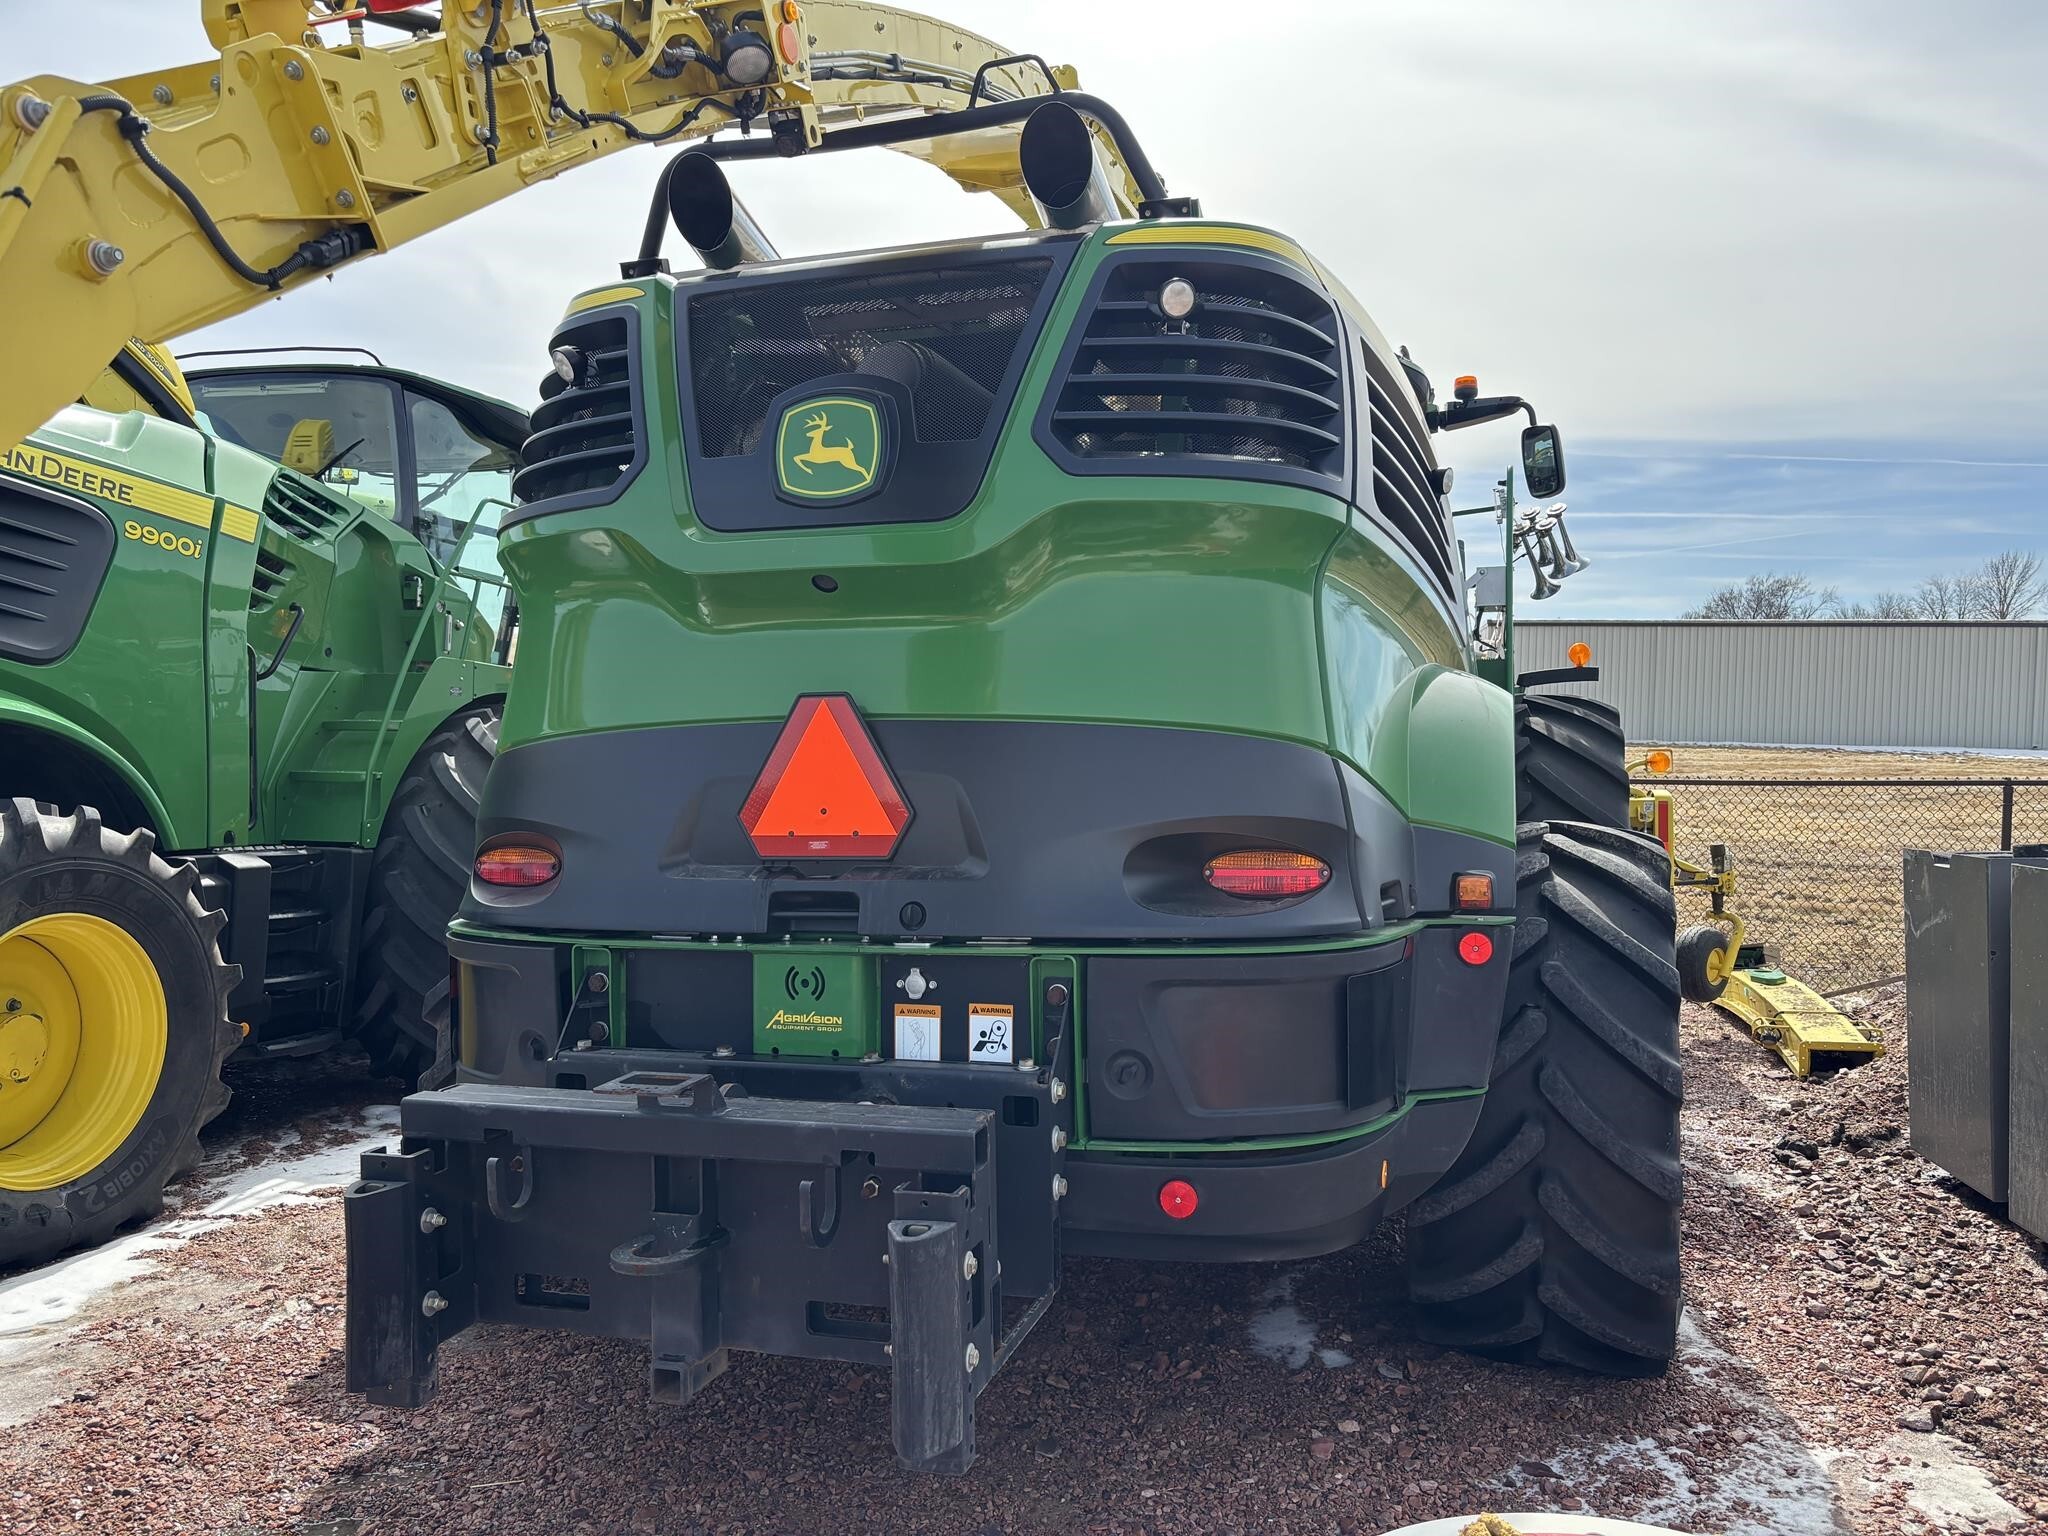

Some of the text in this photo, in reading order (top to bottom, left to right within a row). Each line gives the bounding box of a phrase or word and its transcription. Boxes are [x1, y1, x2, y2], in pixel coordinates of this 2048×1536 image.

[146, 351, 164, 371] 3000
[40, 455, 134, 503] DEERE
[123, 519, 203, 560] 9900i
[765, 1009, 843, 1029] AGRIVISION
[906, 1008, 936, 1016] WARNING
[980, 1007, 1012, 1015] WARNING
[772, 1024, 815, 1032] EQUIPMENT
